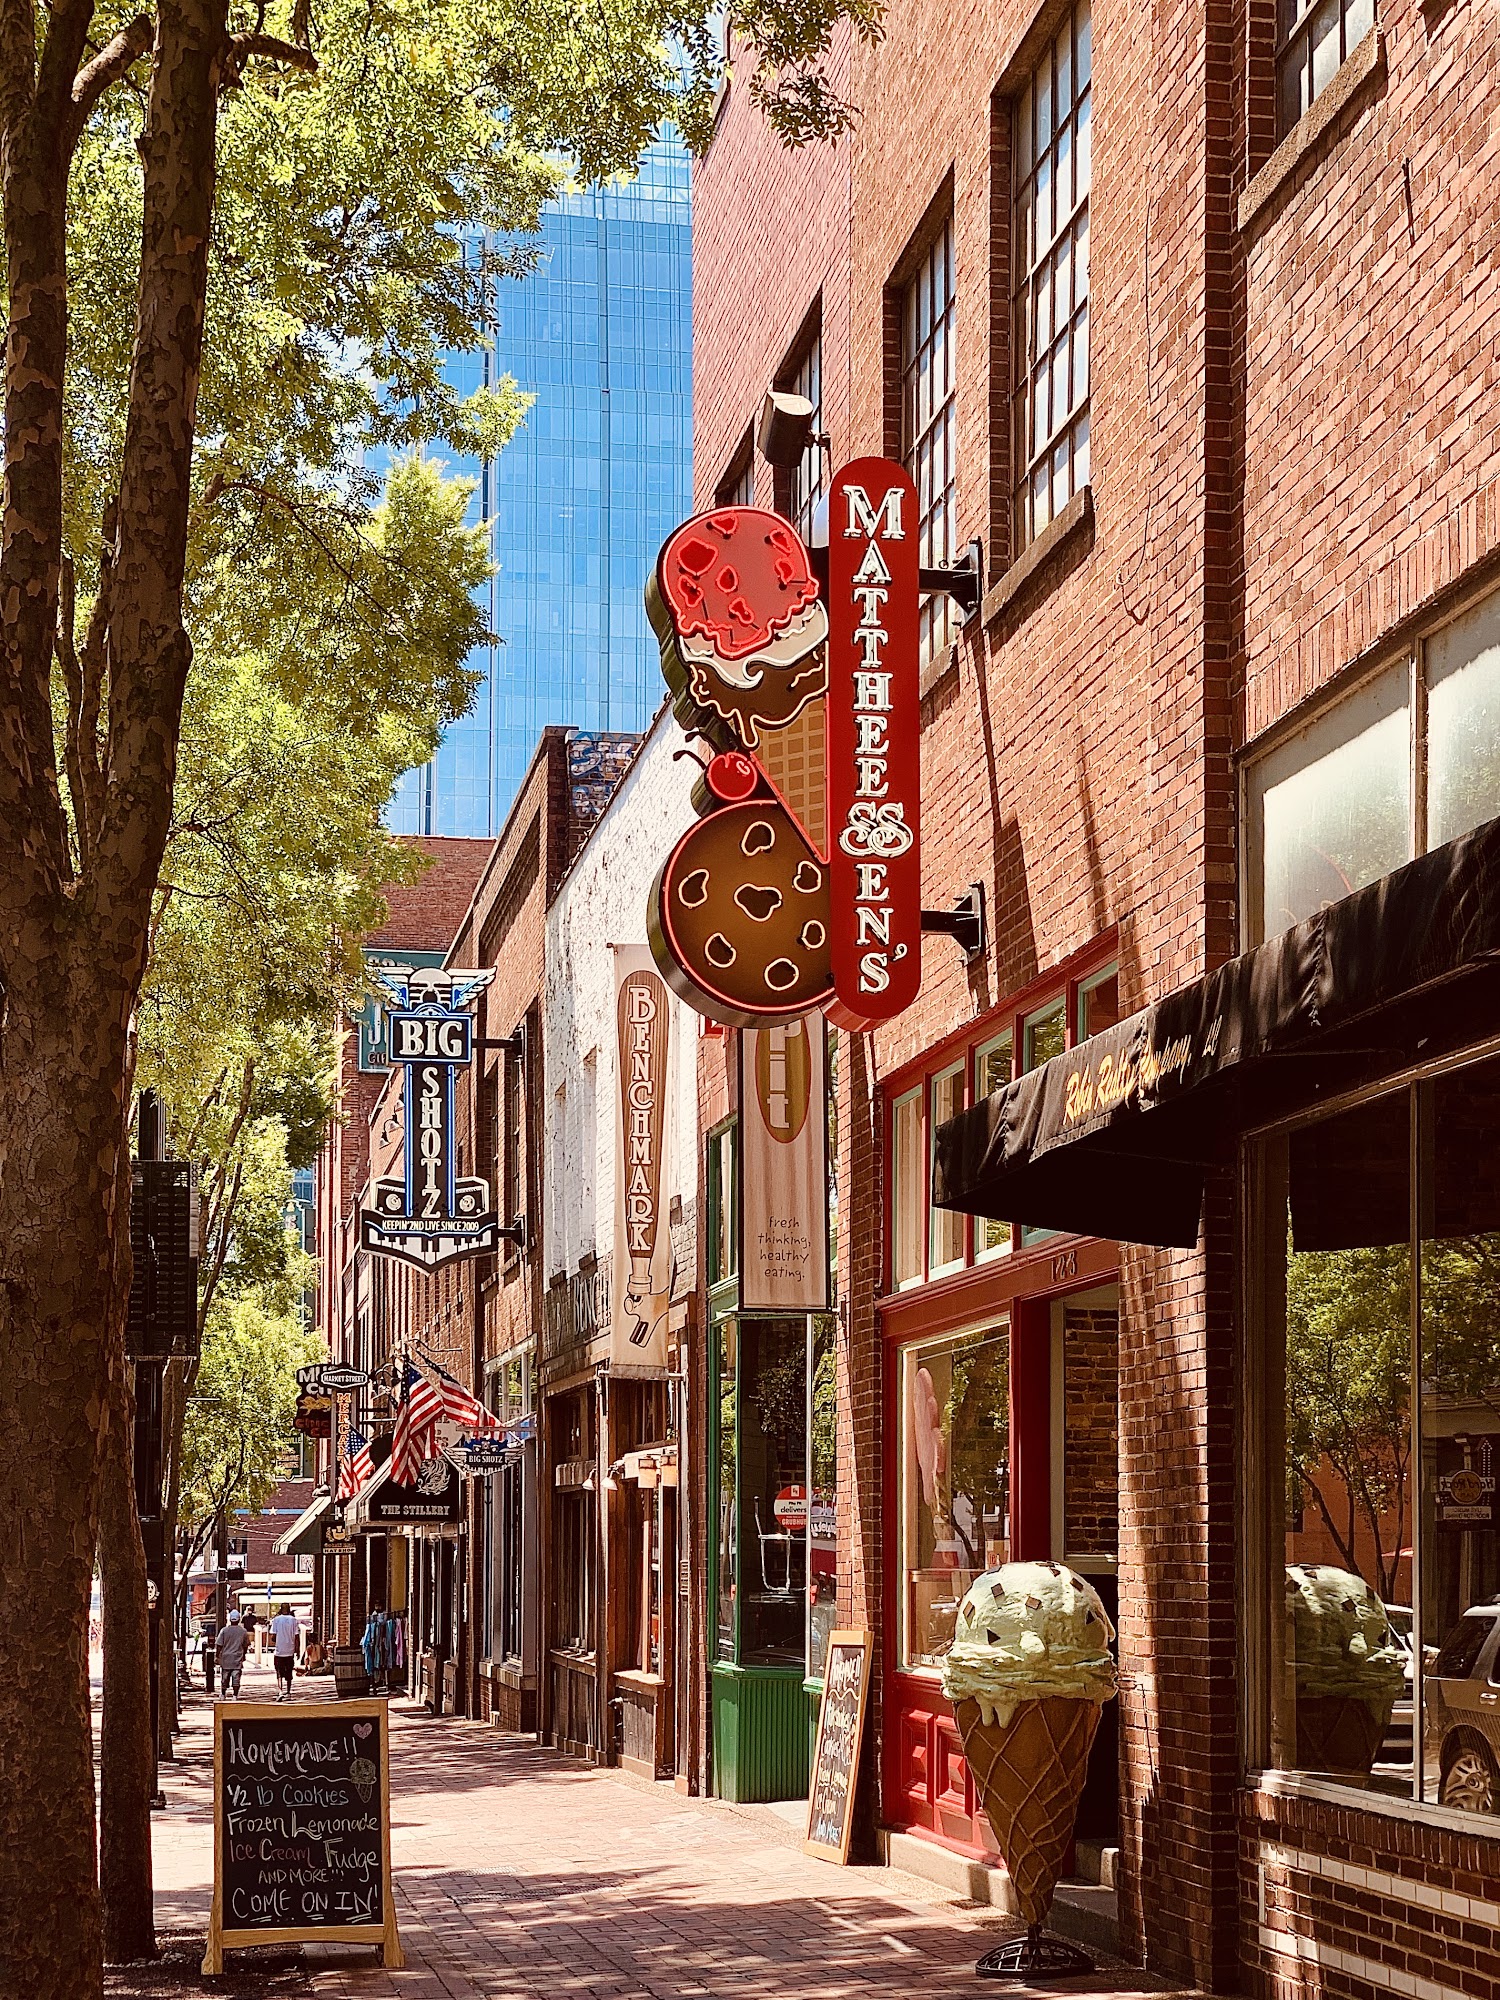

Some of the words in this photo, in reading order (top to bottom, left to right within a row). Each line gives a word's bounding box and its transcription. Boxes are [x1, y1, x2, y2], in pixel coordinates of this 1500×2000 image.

[399, 1020, 463, 1057] BIG
[626, 985, 656, 1252] BENCHMARK
[420, 1066, 443, 1219] SHOTZ
[425, 1220, 440, 1231] LIVE
[441, 1220, 460, 1232] SINCE
[461, 1221, 480, 1232] 2009
[769, 1216, 800, 1228] fresh
[760, 1249, 809, 1265] healthy
[324, 1375, 345, 1383] MARKET
[345, 1375, 365, 1383] STREET
[468, 1455, 481, 1463] BIG
[481, 1455, 503, 1463] SHOTZ
[380, 1504, 401, 1515] THE
[402, 1505, 451, 1516] STILLERY
[256, 1784, 274, 1807] lb
[283, 1783, 349, 1807] Cookies
[227, 1808, 289, 1839] Frozen
[291, 1810, 379, 1841] Lemonade
[229, 1839, 256, 1863] Ice
[259, 1838, 316, 1869] Cream
[323, 1836, 379, 1883] Fudge
[258, 1868, 287, 1885] AND
[301, 1891, 329, 1914] ON
[334, 1884, 379, 1915] IN!
